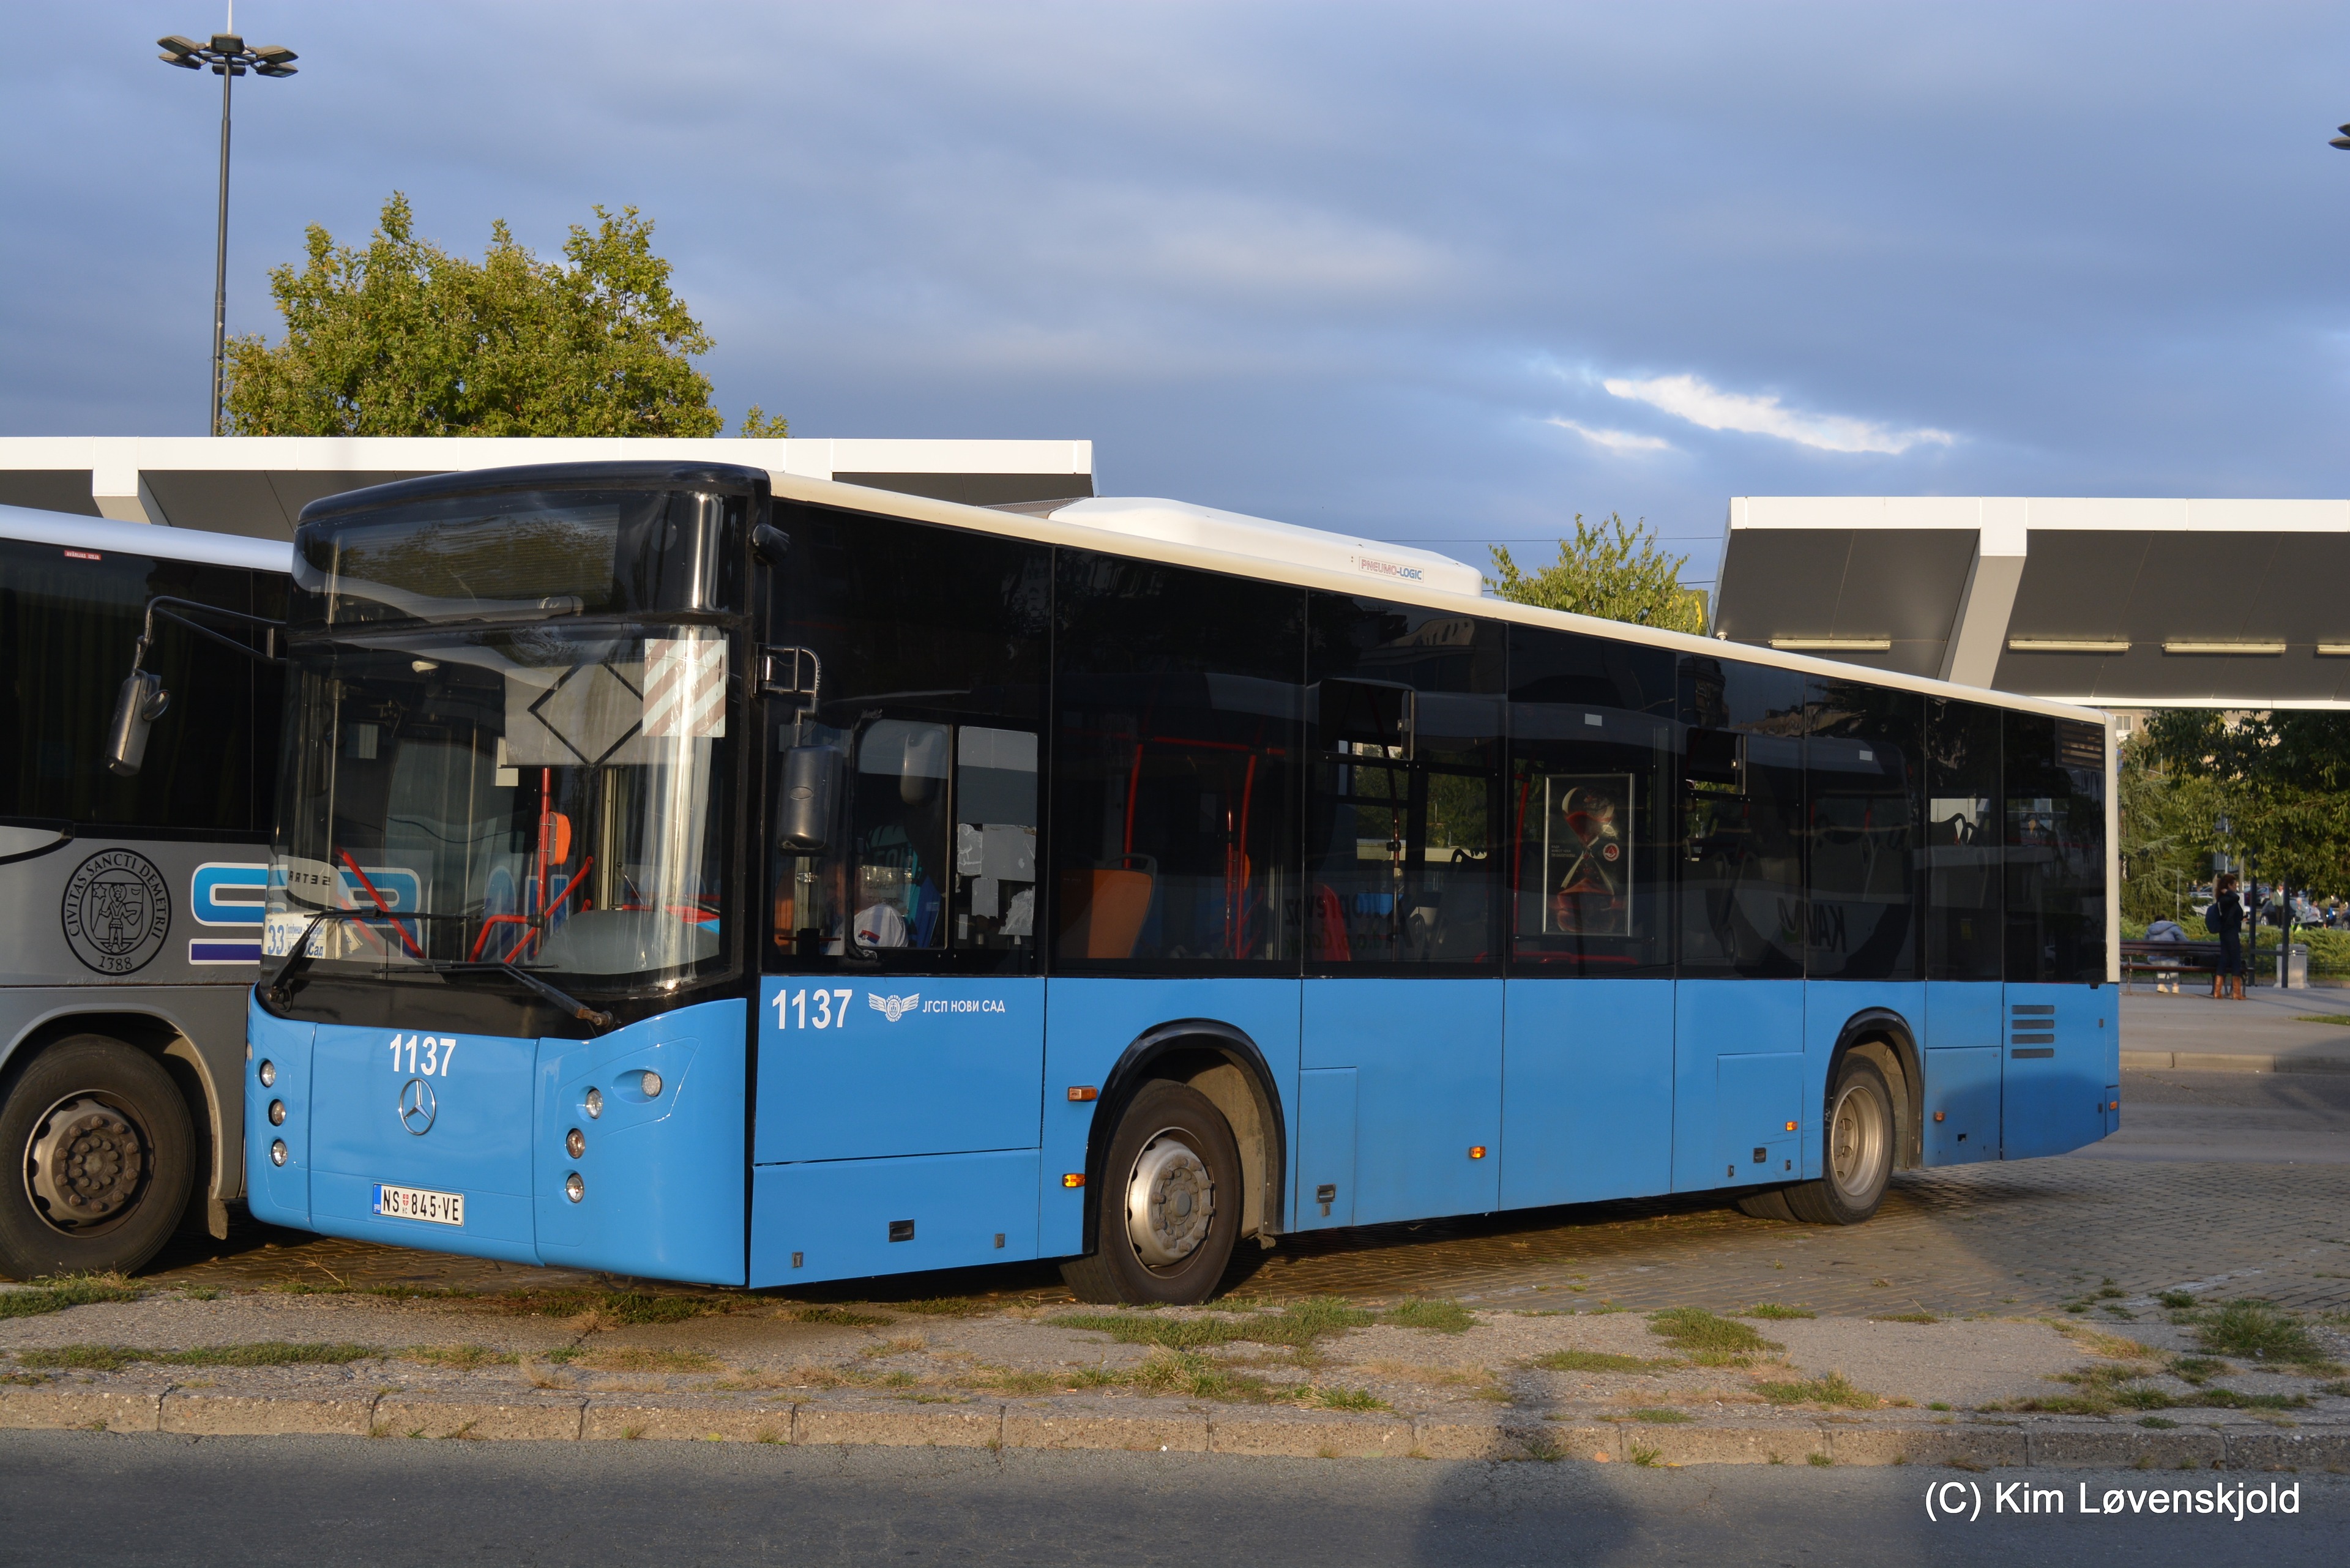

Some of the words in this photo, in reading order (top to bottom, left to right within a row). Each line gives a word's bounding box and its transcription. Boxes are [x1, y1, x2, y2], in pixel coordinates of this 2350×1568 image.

[1361, 559, 1422, 580] PNEUMO-LOGIC
[67, 874, 88, 937] CIVITAS
[86, 853, 137, 877] SANCTI
[139, 864, 167, 939] DEMETRII
[308, 942, 324, 958] Сад
[99, 955, 132, 971] 1388
[772, 989, 852, 1029] 1137
[922, 1000, 948, 1013] ЈГСП
[950, 1000, 979, 1013] НОВИ
[982, 1000, 1005, 1013] САД
[390, 1033, 457, 1077] 1137
[383, 1189, 400, 1212] NS
